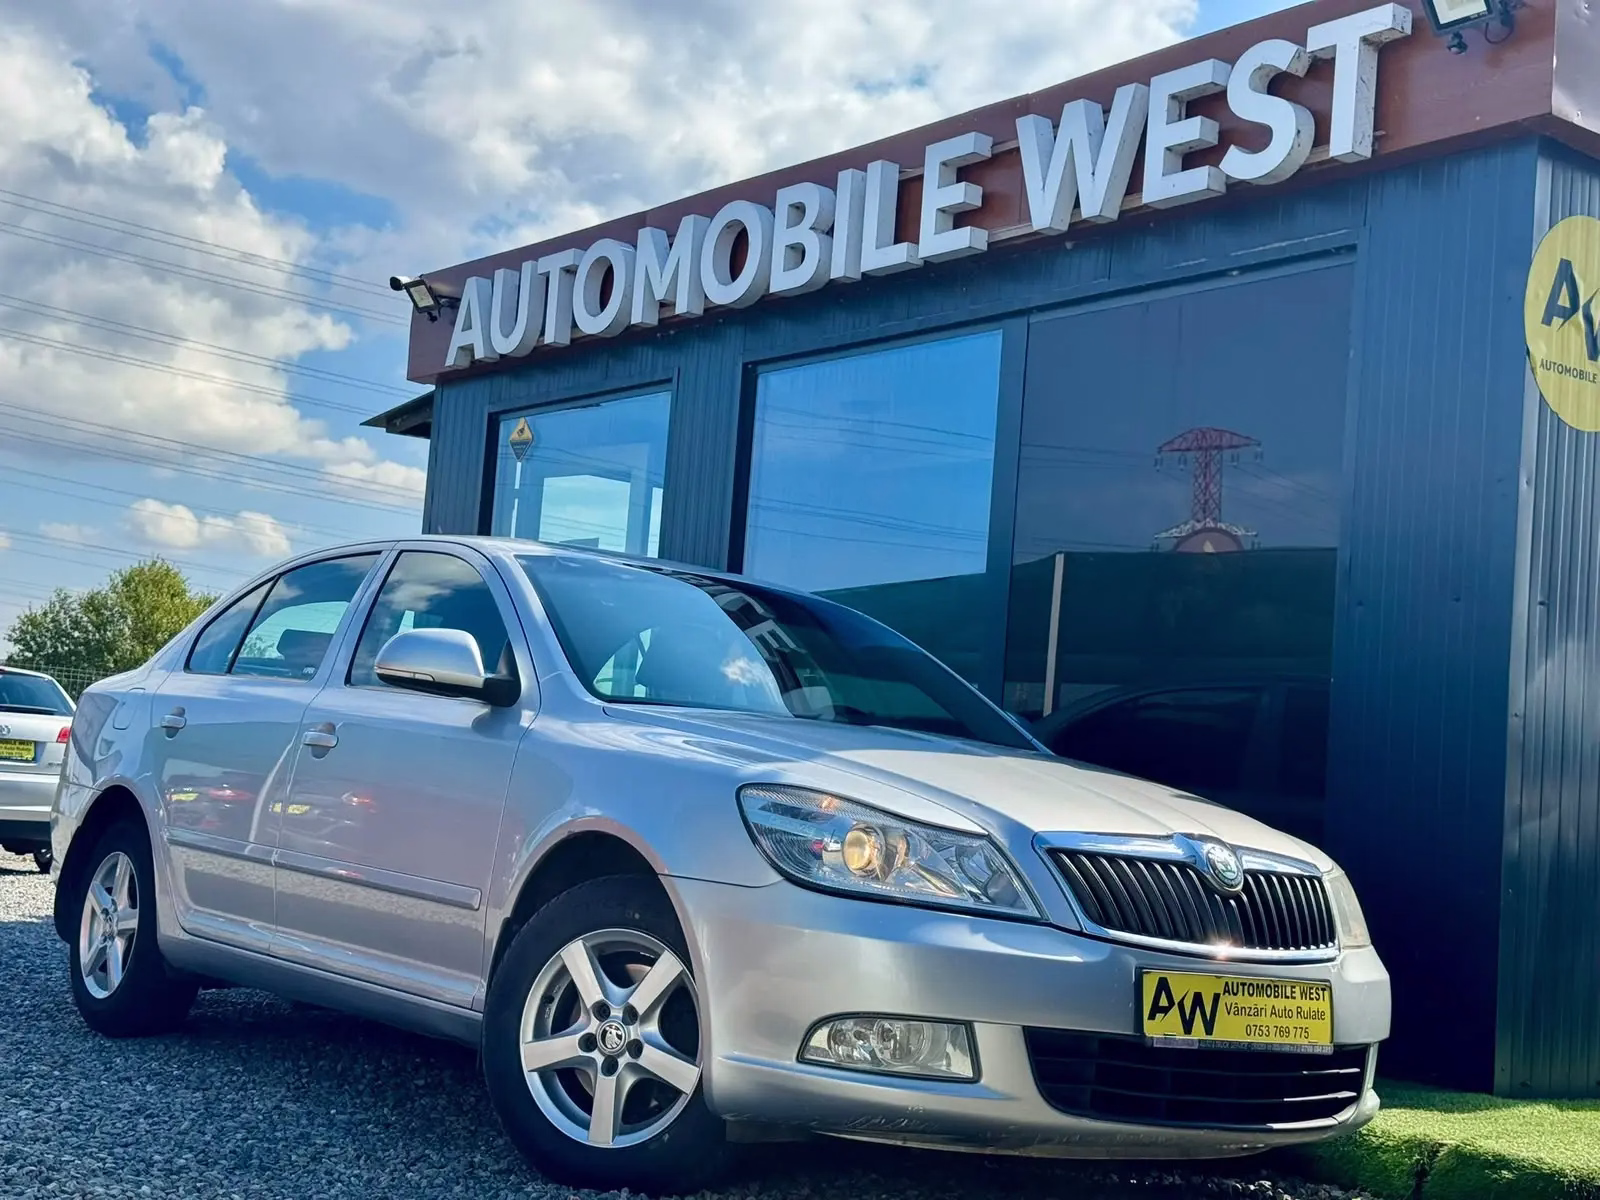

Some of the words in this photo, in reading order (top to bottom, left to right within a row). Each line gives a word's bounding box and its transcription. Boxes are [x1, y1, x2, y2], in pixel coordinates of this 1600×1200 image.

[445, 131, 992, 370] AUTOMOBILE
[1016, 2, 1413, 236] WEST
[1539, 358, 1597, 384] AUTOMOBILE
[1222, 981, 1296, 1000] AUTOMOBILE
[1300, 986, 1327, 1002] WEST
[1270, 1006, 1294, 1019] Auto
[1296, 1007, 1326, 1021] Rulate
[1245, 1024, 1270, 1037] 0753
[1273, 1025, 1290, 1038] 769
[1293, 1026, 1310, 1039] 775
